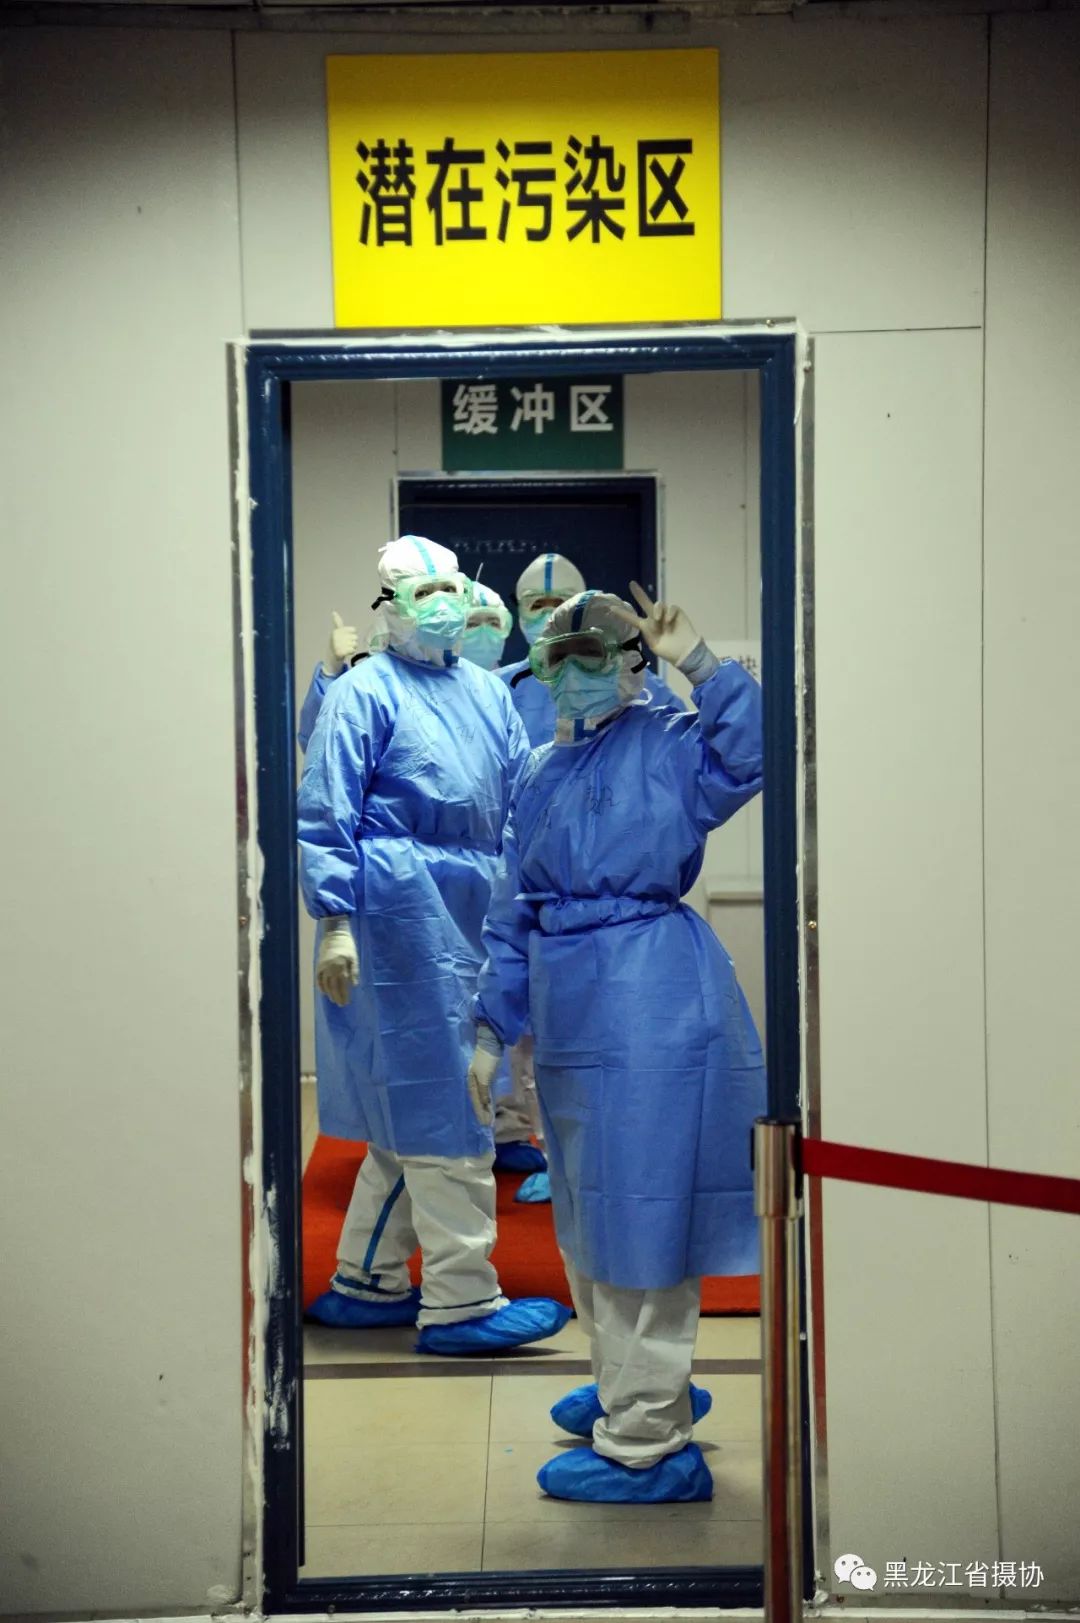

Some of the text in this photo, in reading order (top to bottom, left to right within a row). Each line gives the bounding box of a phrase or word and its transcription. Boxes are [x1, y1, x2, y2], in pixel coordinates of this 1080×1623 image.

[355, 134, 695, 247] 潜在污染区
[452, 383, 614, 434] 缓冲区
